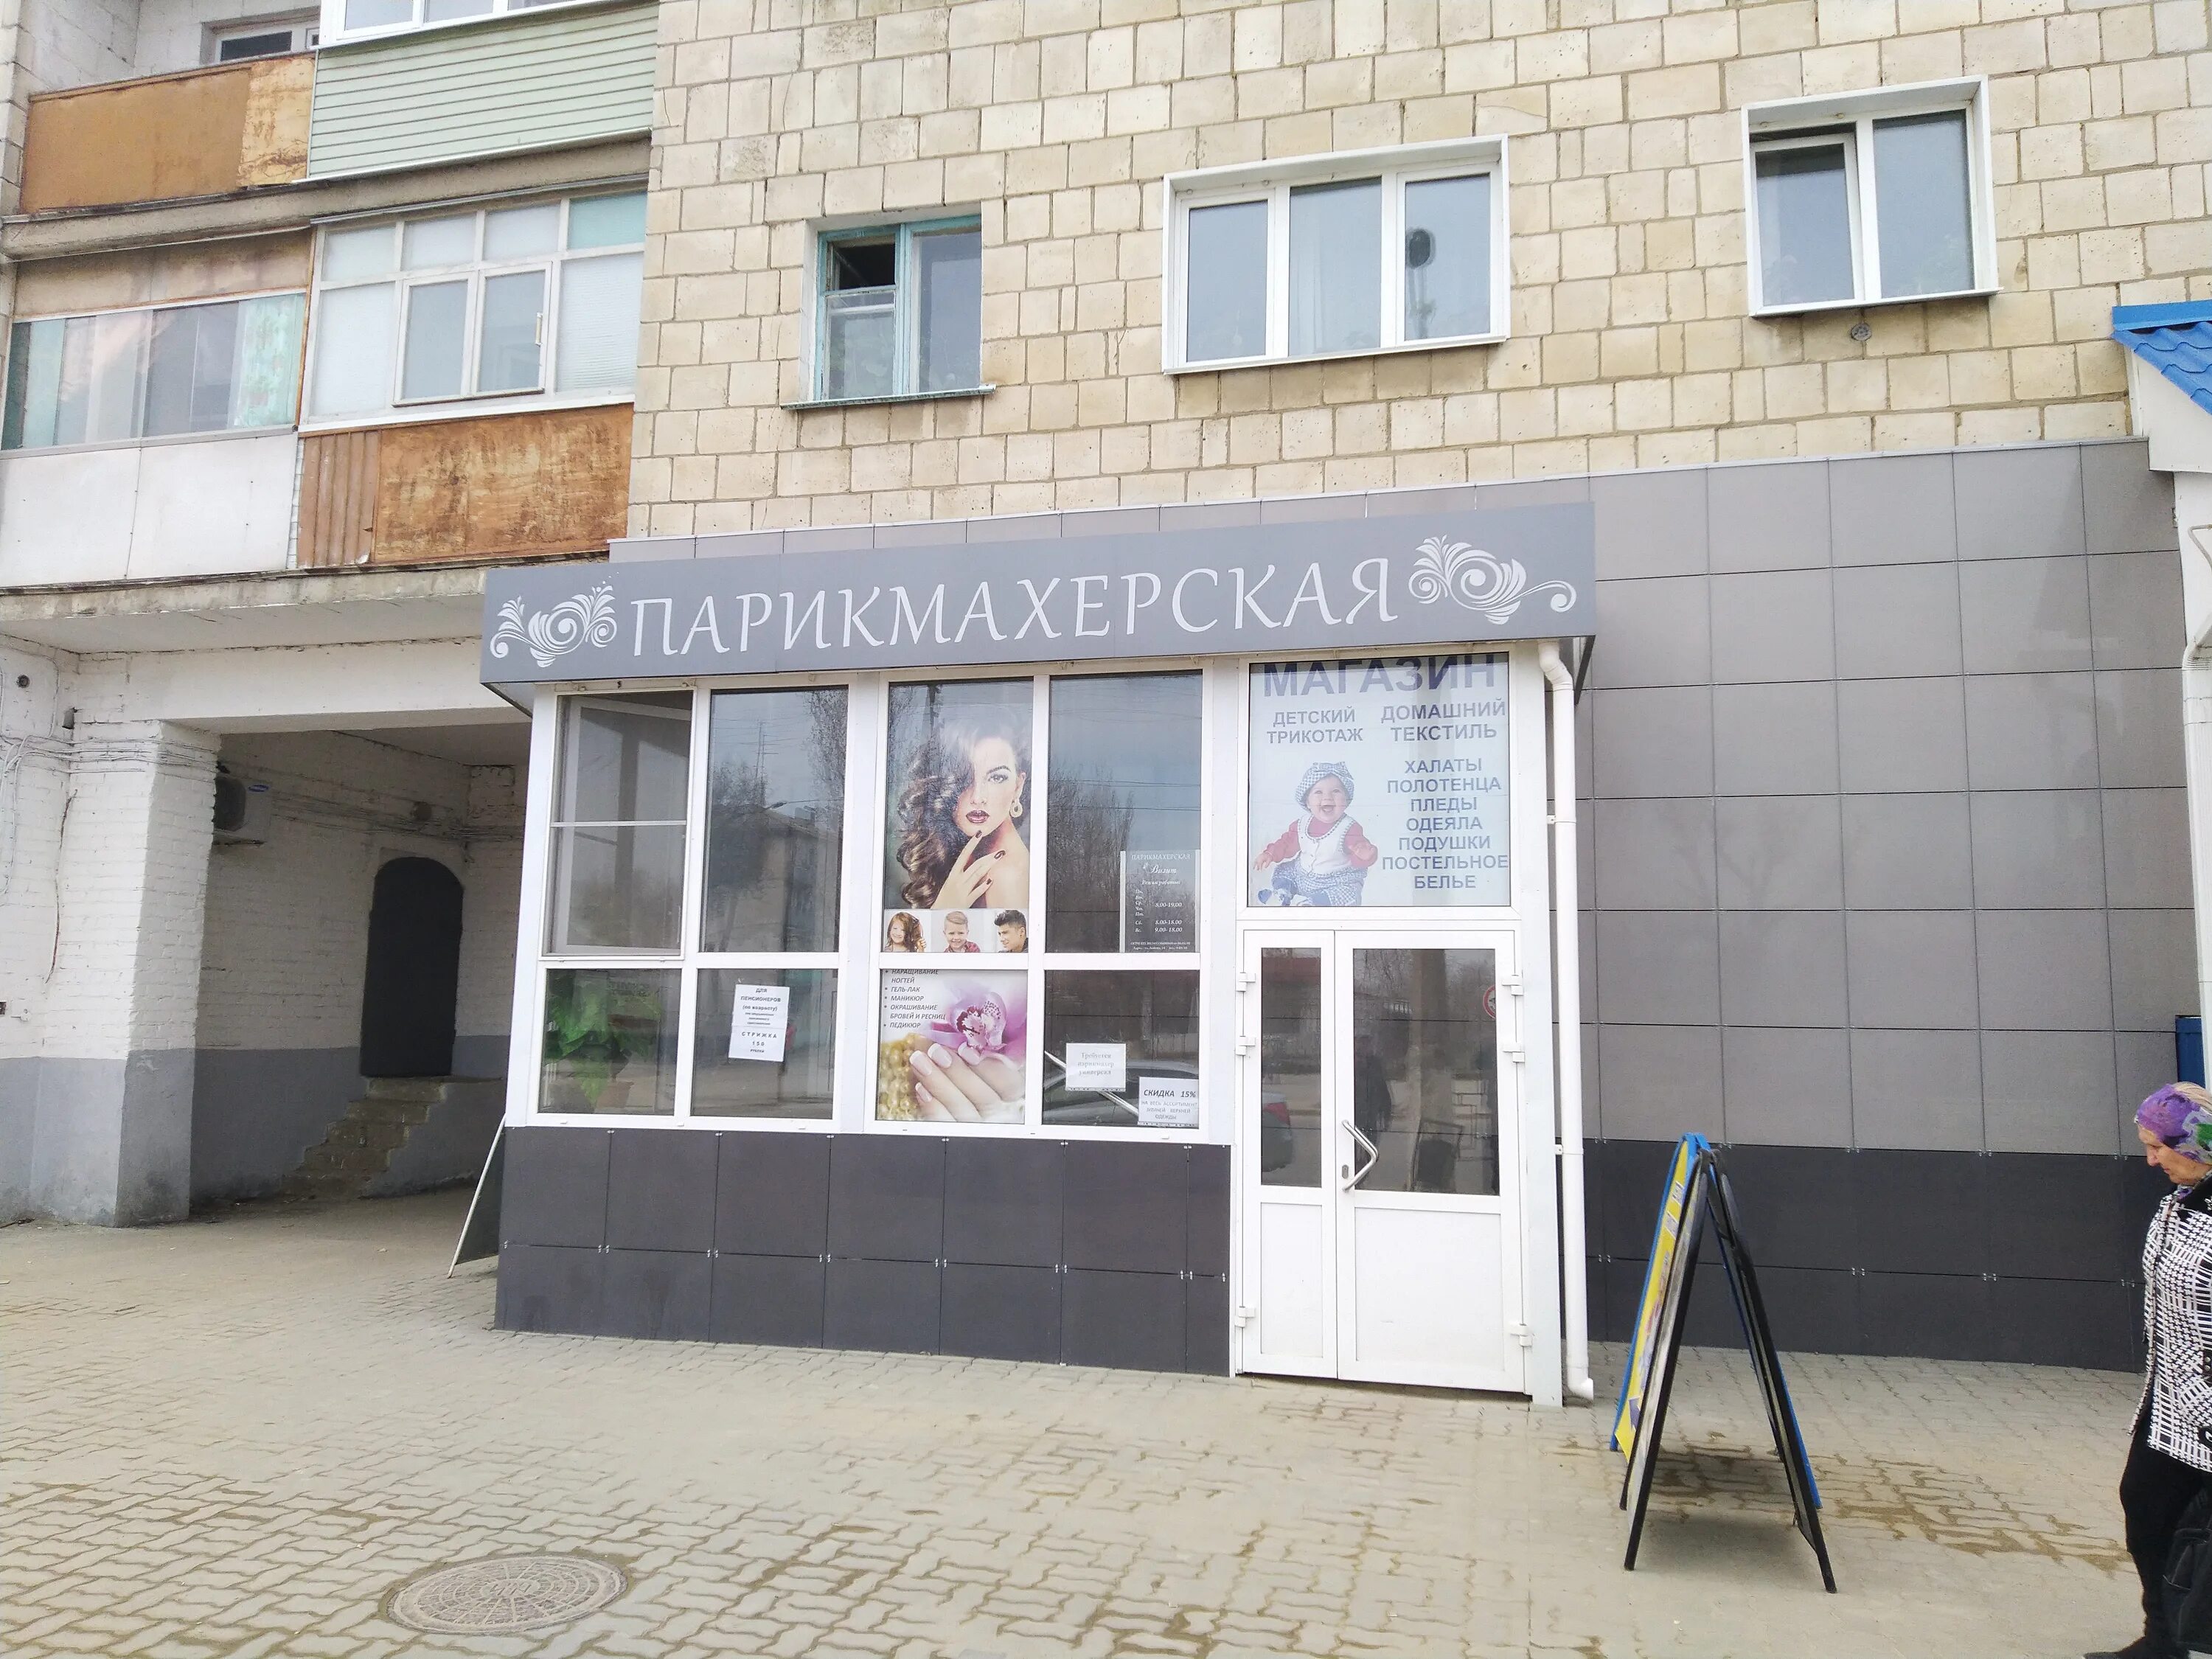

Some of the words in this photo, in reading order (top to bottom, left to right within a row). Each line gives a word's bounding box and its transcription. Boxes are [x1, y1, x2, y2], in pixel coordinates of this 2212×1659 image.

[630, 557, 1399, 657] ПАРИКМАХЕРСКАЯ
[1263, 653, 1495, 697] МАГАЗИН
[1273, 706, 1356, 727] ДЕТСКИЙ
[1381, 698, 1506, 723] ДОМАШНИЙ
[1267, 728, 1363, 744] ТРИКОТАЖ
[1391, 724, 1497, 742] ТЕКСТИЛЬ
[1405, 759, 1482, 773] ХАЛАТЫ
[1388, 777, 1502, 793] ПОЛОТЕНЦА
[1411, 797, 1478, 812] ПЛЕДЫ
[1406, 817, 1483, 832] ОДЕЯЛА
[1399, 835, 1491, 852] ПОДУШКИ
[1150, 864, 1177, 874] Визит
[1382, 855, 1509, 870] ПОСТЕЛЬНОЕ
[1414, 875, 1476, 889] БЕЛЬЕ
[1144, 1089, 1175, 1098] СКИДКА
